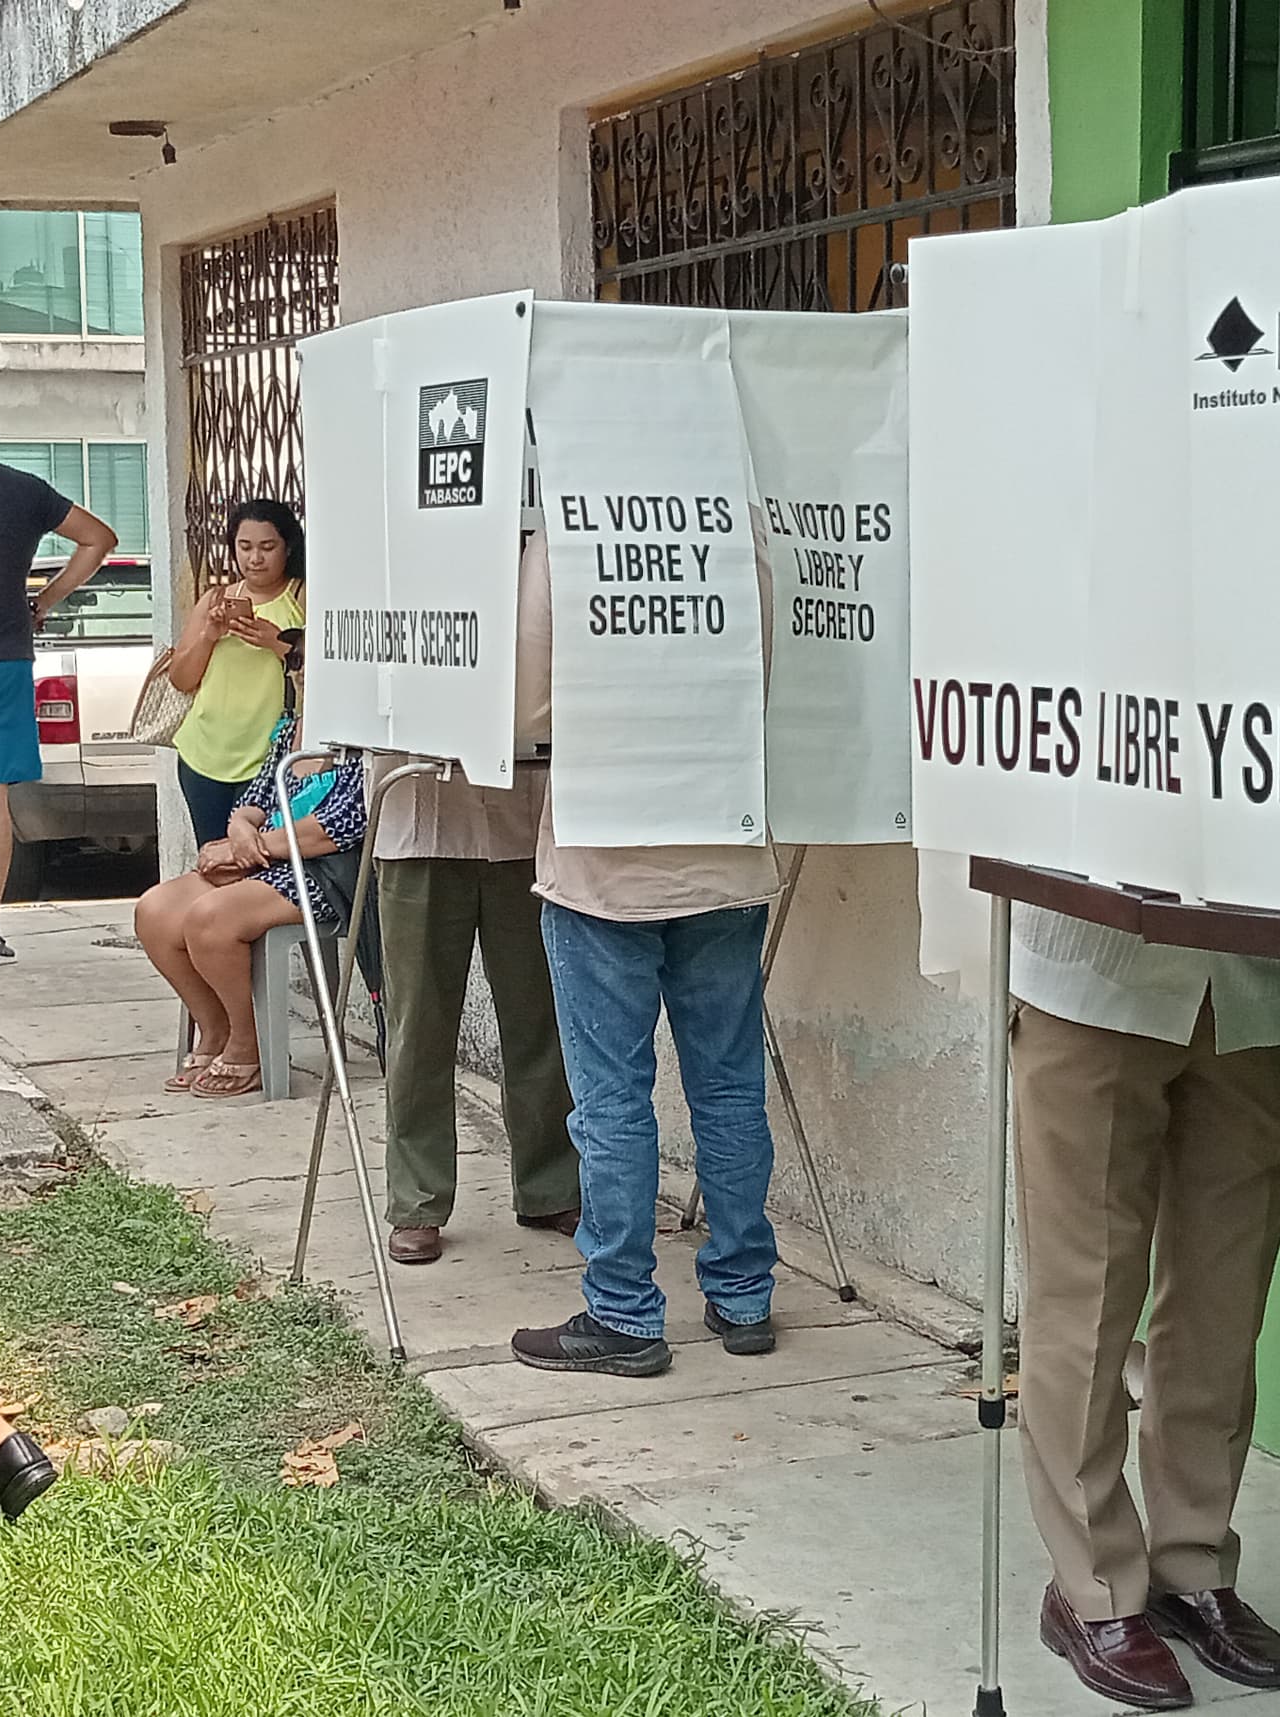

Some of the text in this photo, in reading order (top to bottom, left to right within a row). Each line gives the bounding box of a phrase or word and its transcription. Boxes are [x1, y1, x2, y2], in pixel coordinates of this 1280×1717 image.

[1193, 387, 1266, 410] Instituto
[429, 450, 472, 485] IEPC
[424, 486, 476, 504] TABASCO
[561, 496, 733, 533] EL VOTO ES
[765, 497, 891, 542] EL VOTO ES
[597, 543, 710, 582] LIBRE Y
[794, 548, 864, 591] LIBRE Y
[589, 595, 725, 635] SECRETO
[792, 597, 875, 642] SECRETO
[324, 609, 478, 668] EL VOTO ES LIBRE Y SECRETO
[913, 678, 1021, 771] VOTO
[1029, 686, 1082, 777] ES
[1097, 691, 1182, 794] LIBRE
[1197, 703, 1233, 799] Y
